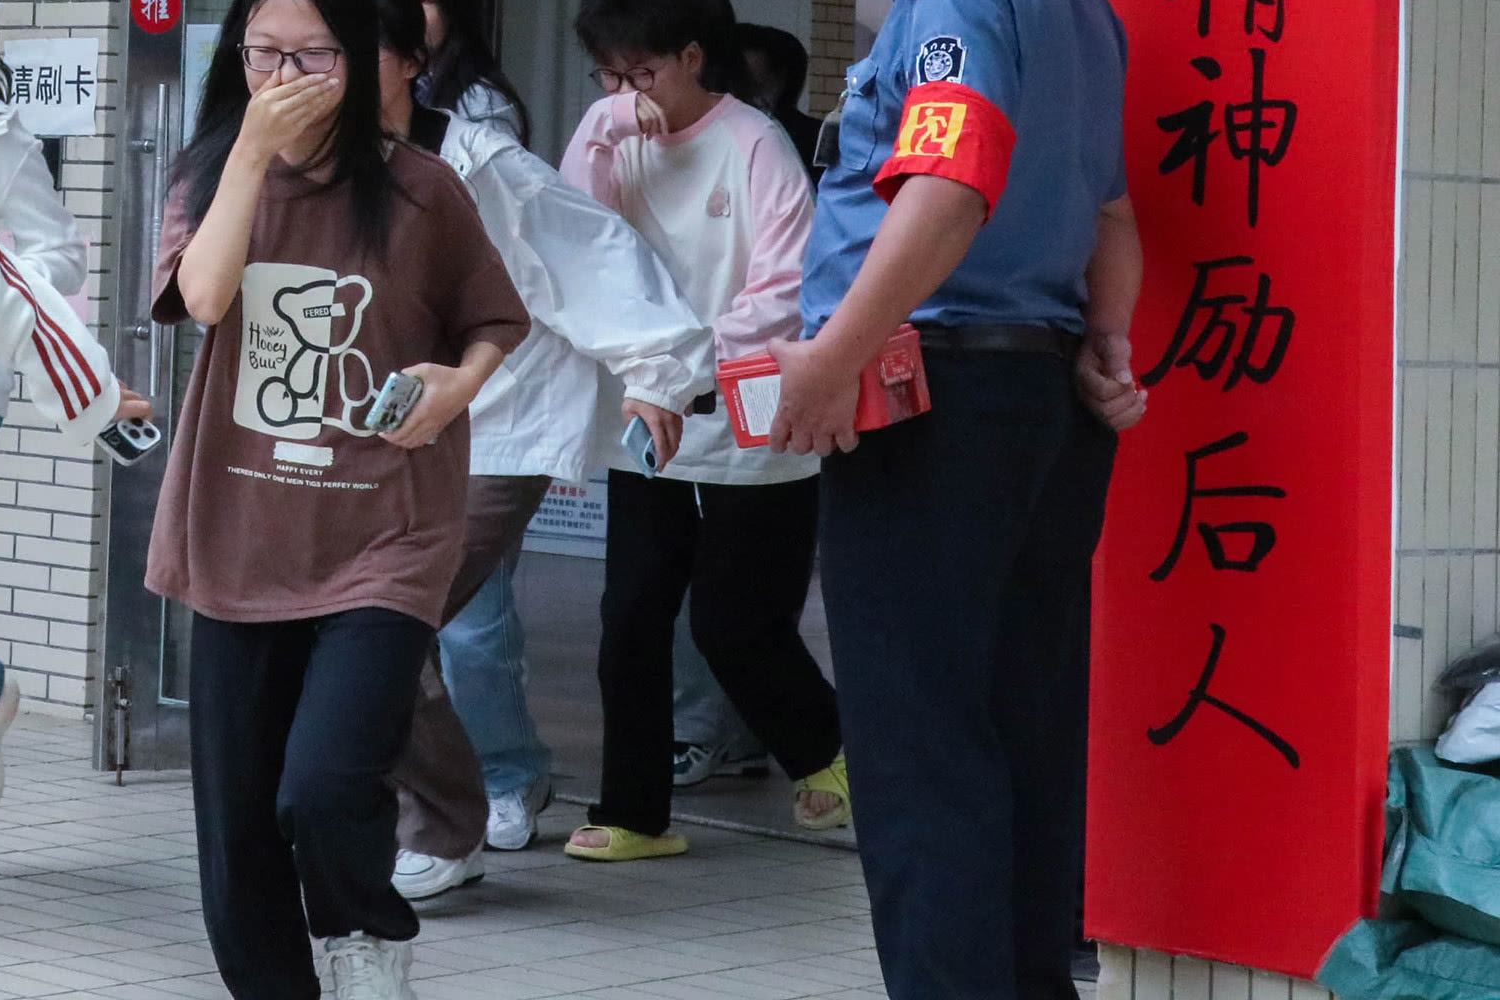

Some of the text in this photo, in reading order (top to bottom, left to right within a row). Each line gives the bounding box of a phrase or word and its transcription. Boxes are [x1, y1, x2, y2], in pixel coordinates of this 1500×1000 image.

[276, 464, 323, 476] HAPPY EVERY
[254, 471, 272, 480] ONLY
